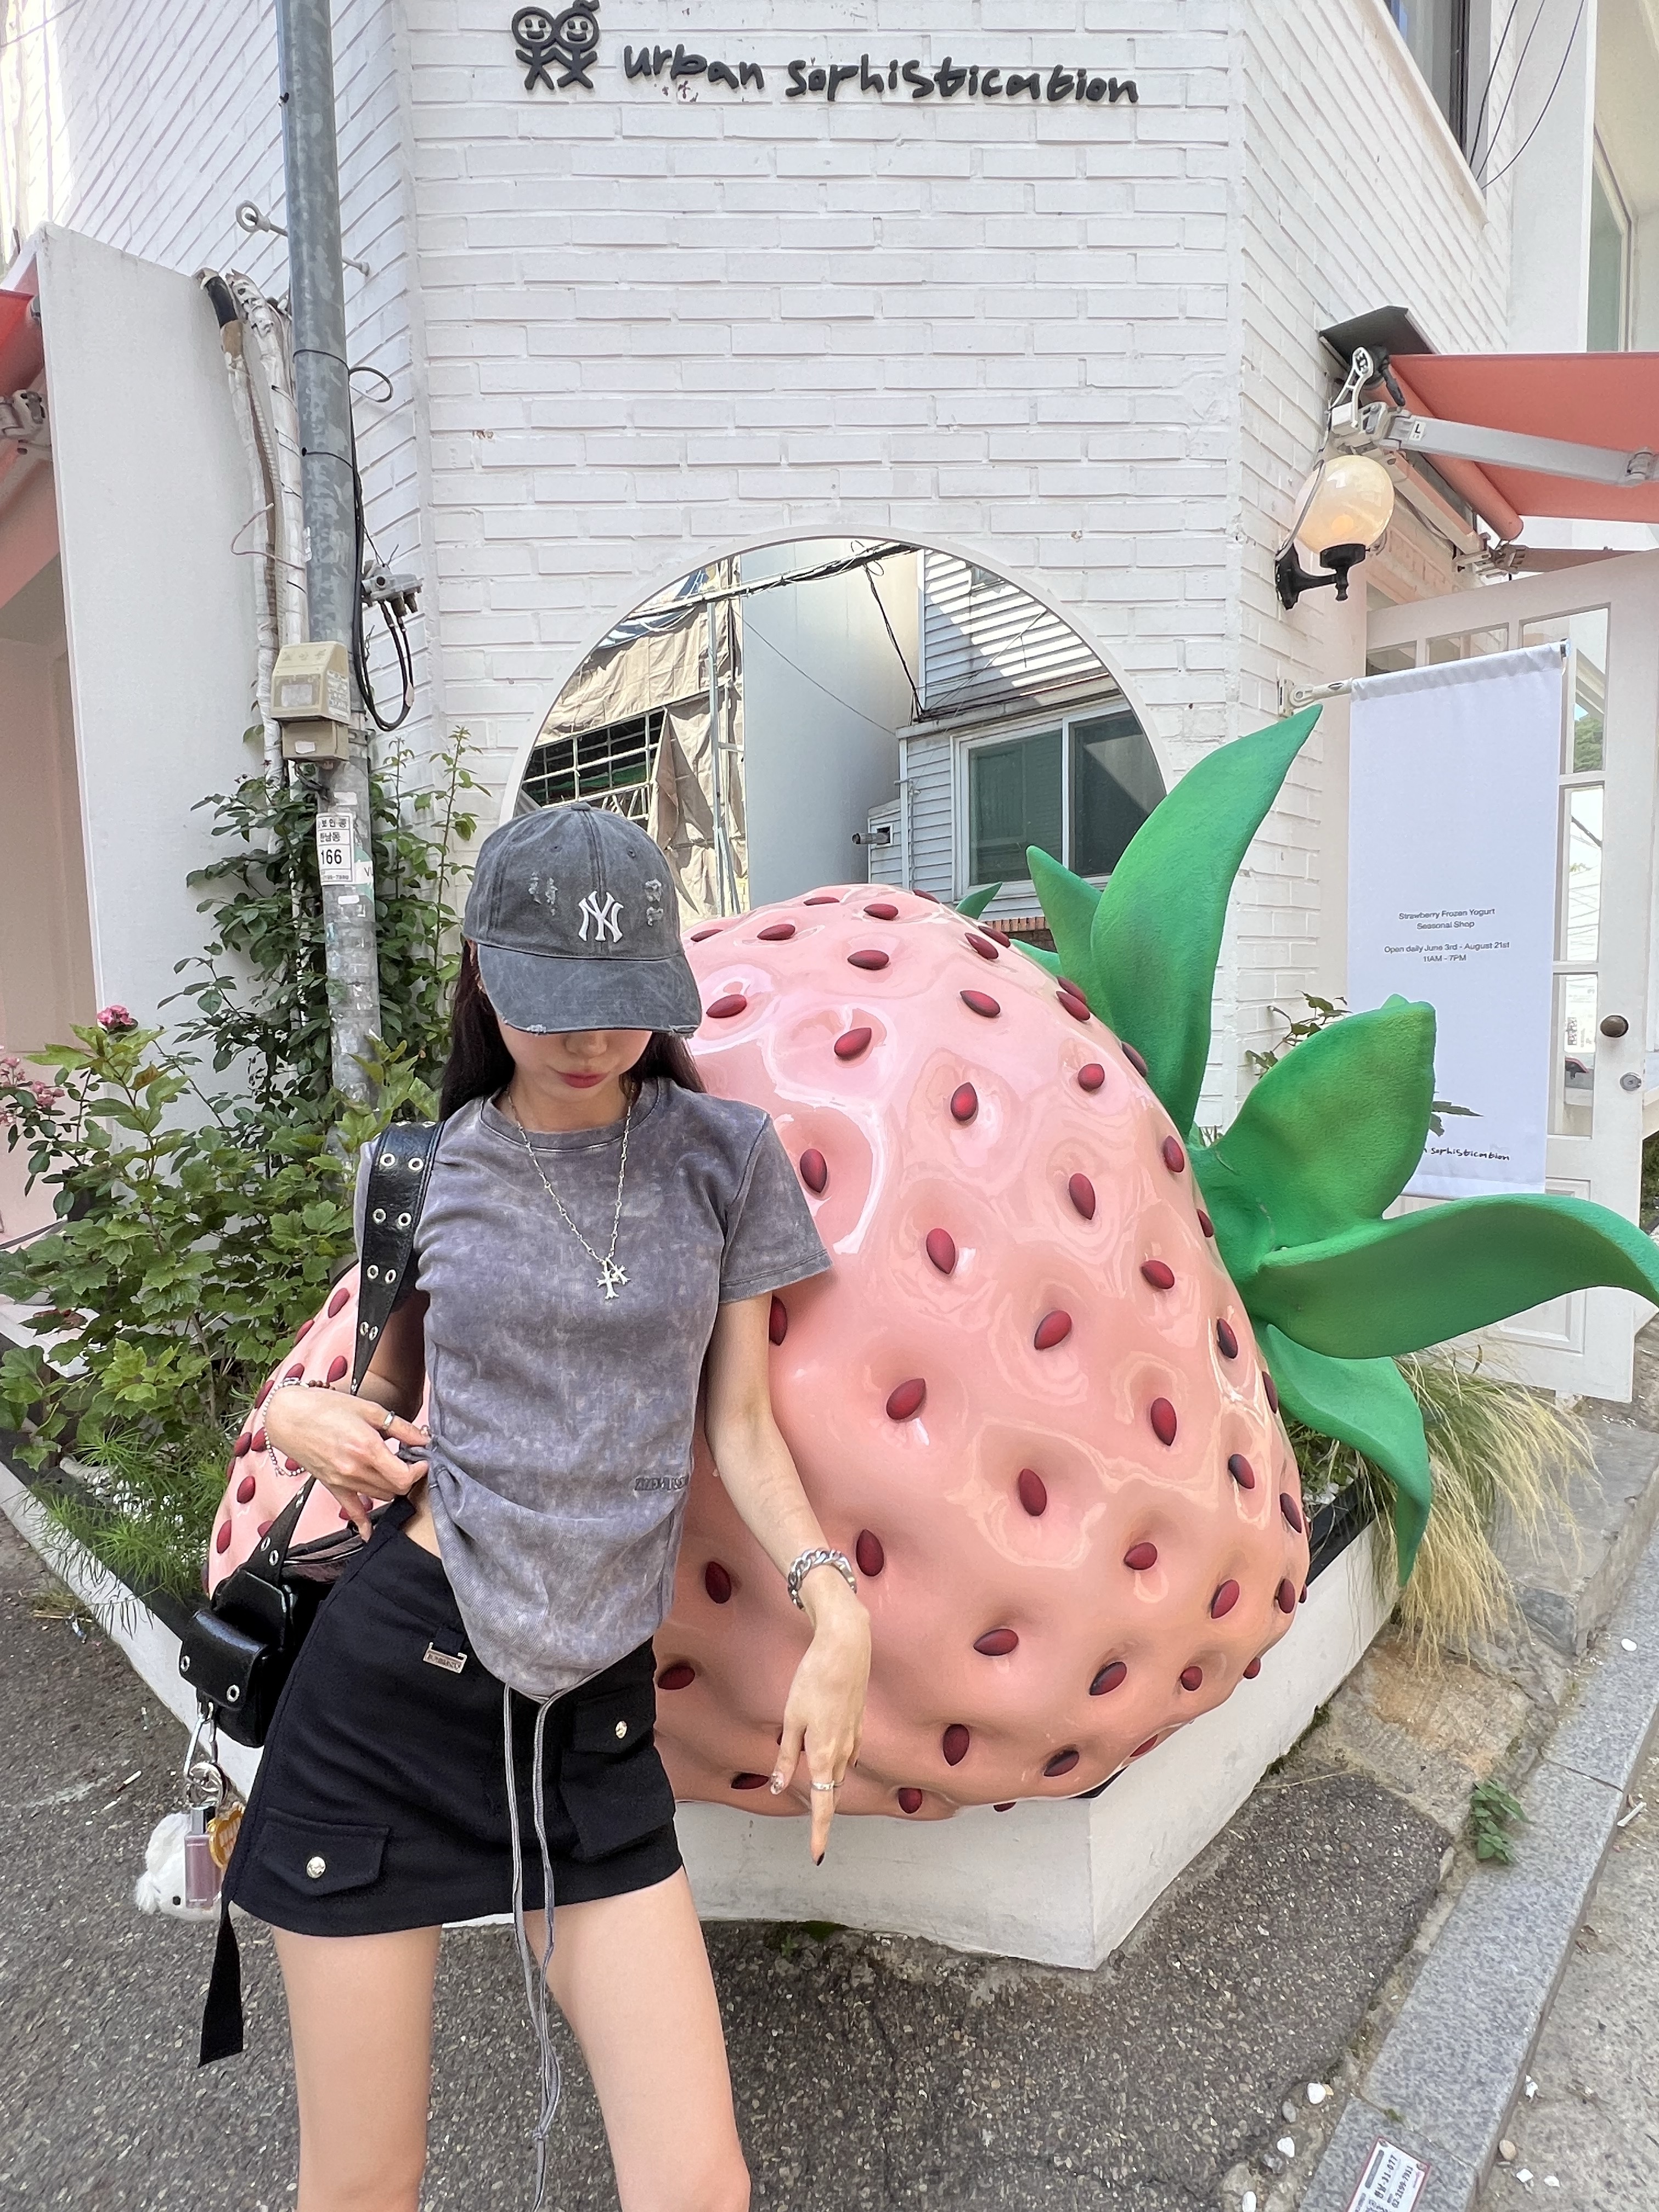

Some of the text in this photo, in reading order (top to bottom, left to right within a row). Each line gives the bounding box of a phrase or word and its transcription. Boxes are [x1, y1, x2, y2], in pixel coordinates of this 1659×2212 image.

[625, 44, 1139, 103] urban sophistication
[320, 849, 342, 865] 166
[1406, 945, 1423, 953] daily
[1464, 942, 1493, 951] August
[1431, 1147, 1510, 1161] sophistication
